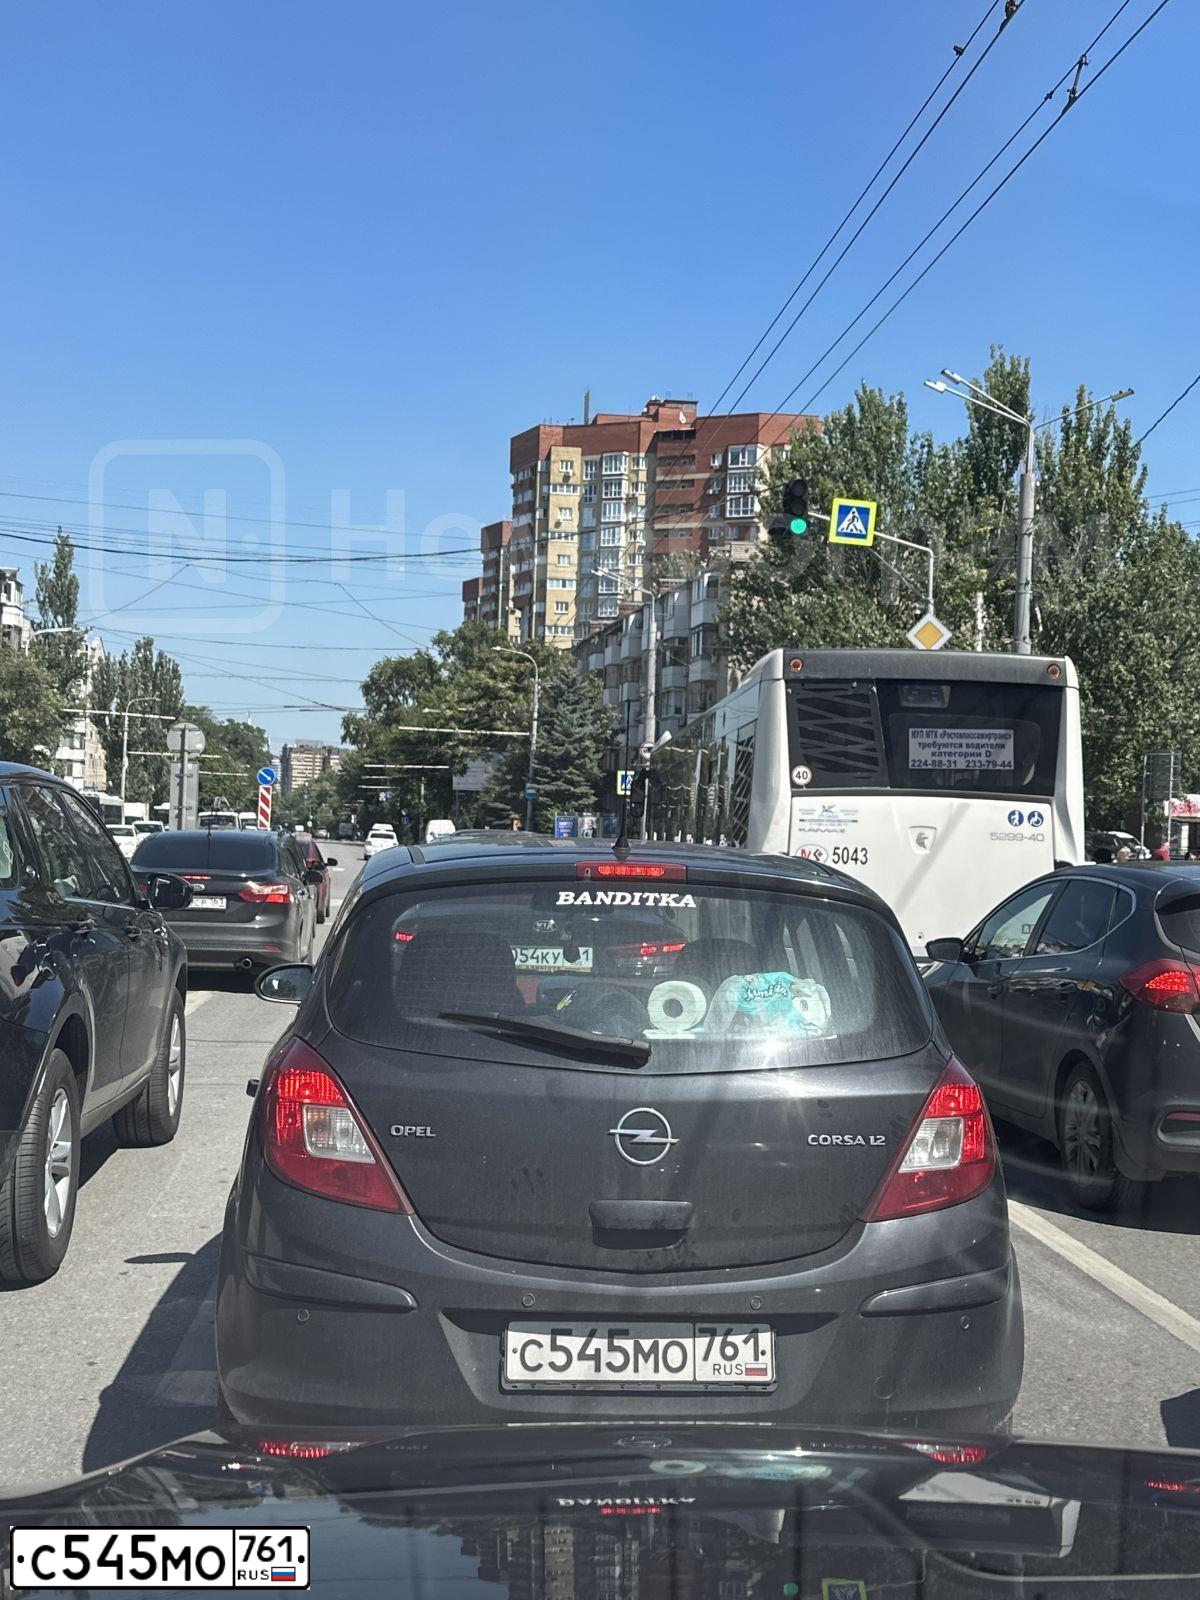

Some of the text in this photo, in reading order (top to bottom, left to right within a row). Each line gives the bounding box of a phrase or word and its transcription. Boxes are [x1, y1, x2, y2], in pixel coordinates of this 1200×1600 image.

[918, 741, 1006, 751] требуются водители
[931, 750, 992, 759] категории D
[911, 760, 1012, 768] 224-88-31 233-79-44
[795, 770, 808, 780] 40
[990, 832, 1045, 842] 5299-40
[832, 846, 869, 865] 5043
[556, 891, 697, 908] BANDITKA
[390, 1124, 437, 1137] OPEL
[807, 1134, 866, 1146] CORSA
[519, 1327, 760, 1374] С545МО 761
[712, 1363, 744, 1376] RUS
